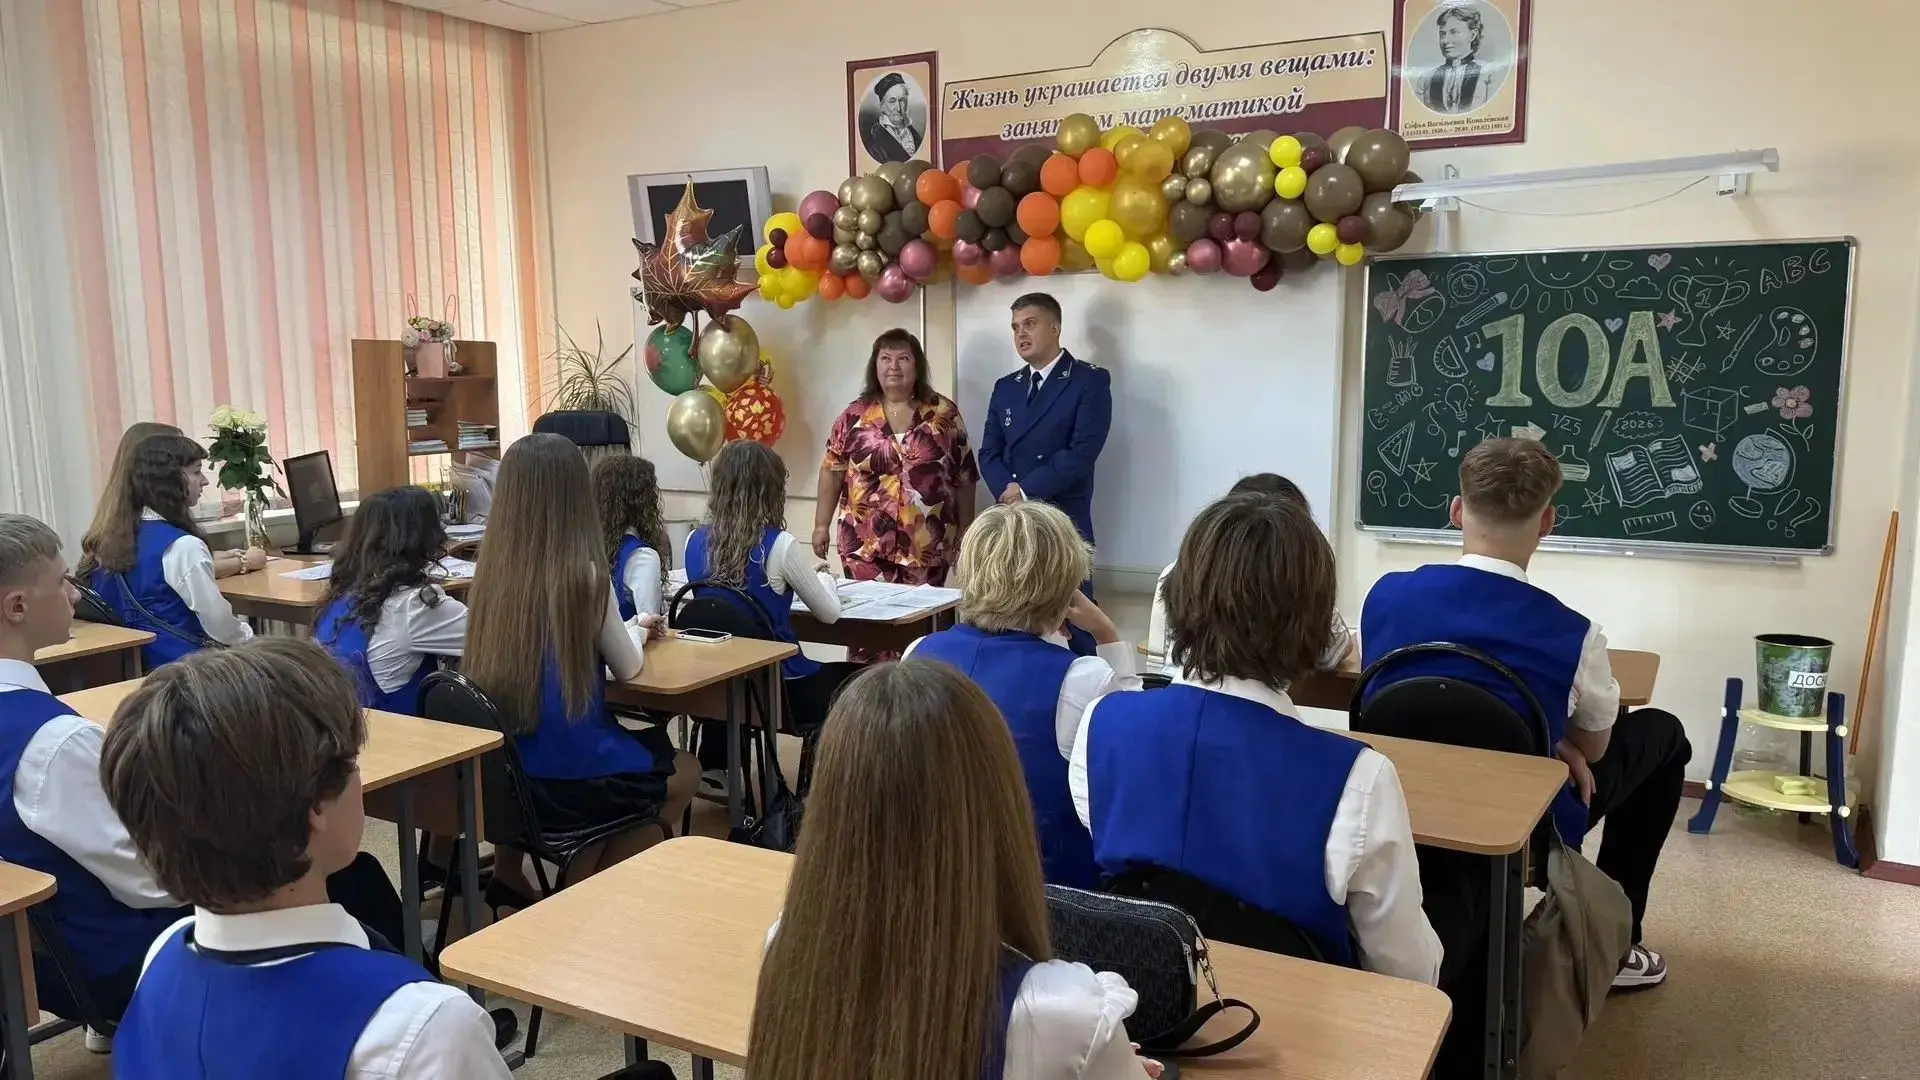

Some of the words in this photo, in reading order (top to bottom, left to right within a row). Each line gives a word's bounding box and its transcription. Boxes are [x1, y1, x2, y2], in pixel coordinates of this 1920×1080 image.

[950, 88, 1019, 110] Жизнь
[1024, 71, 1169, 107] украшается
[1175, 62, 1253, 88] двумя
[1260, 48, 1375, 77] вещами:
[1119, 87, 1304, 126] математикой
